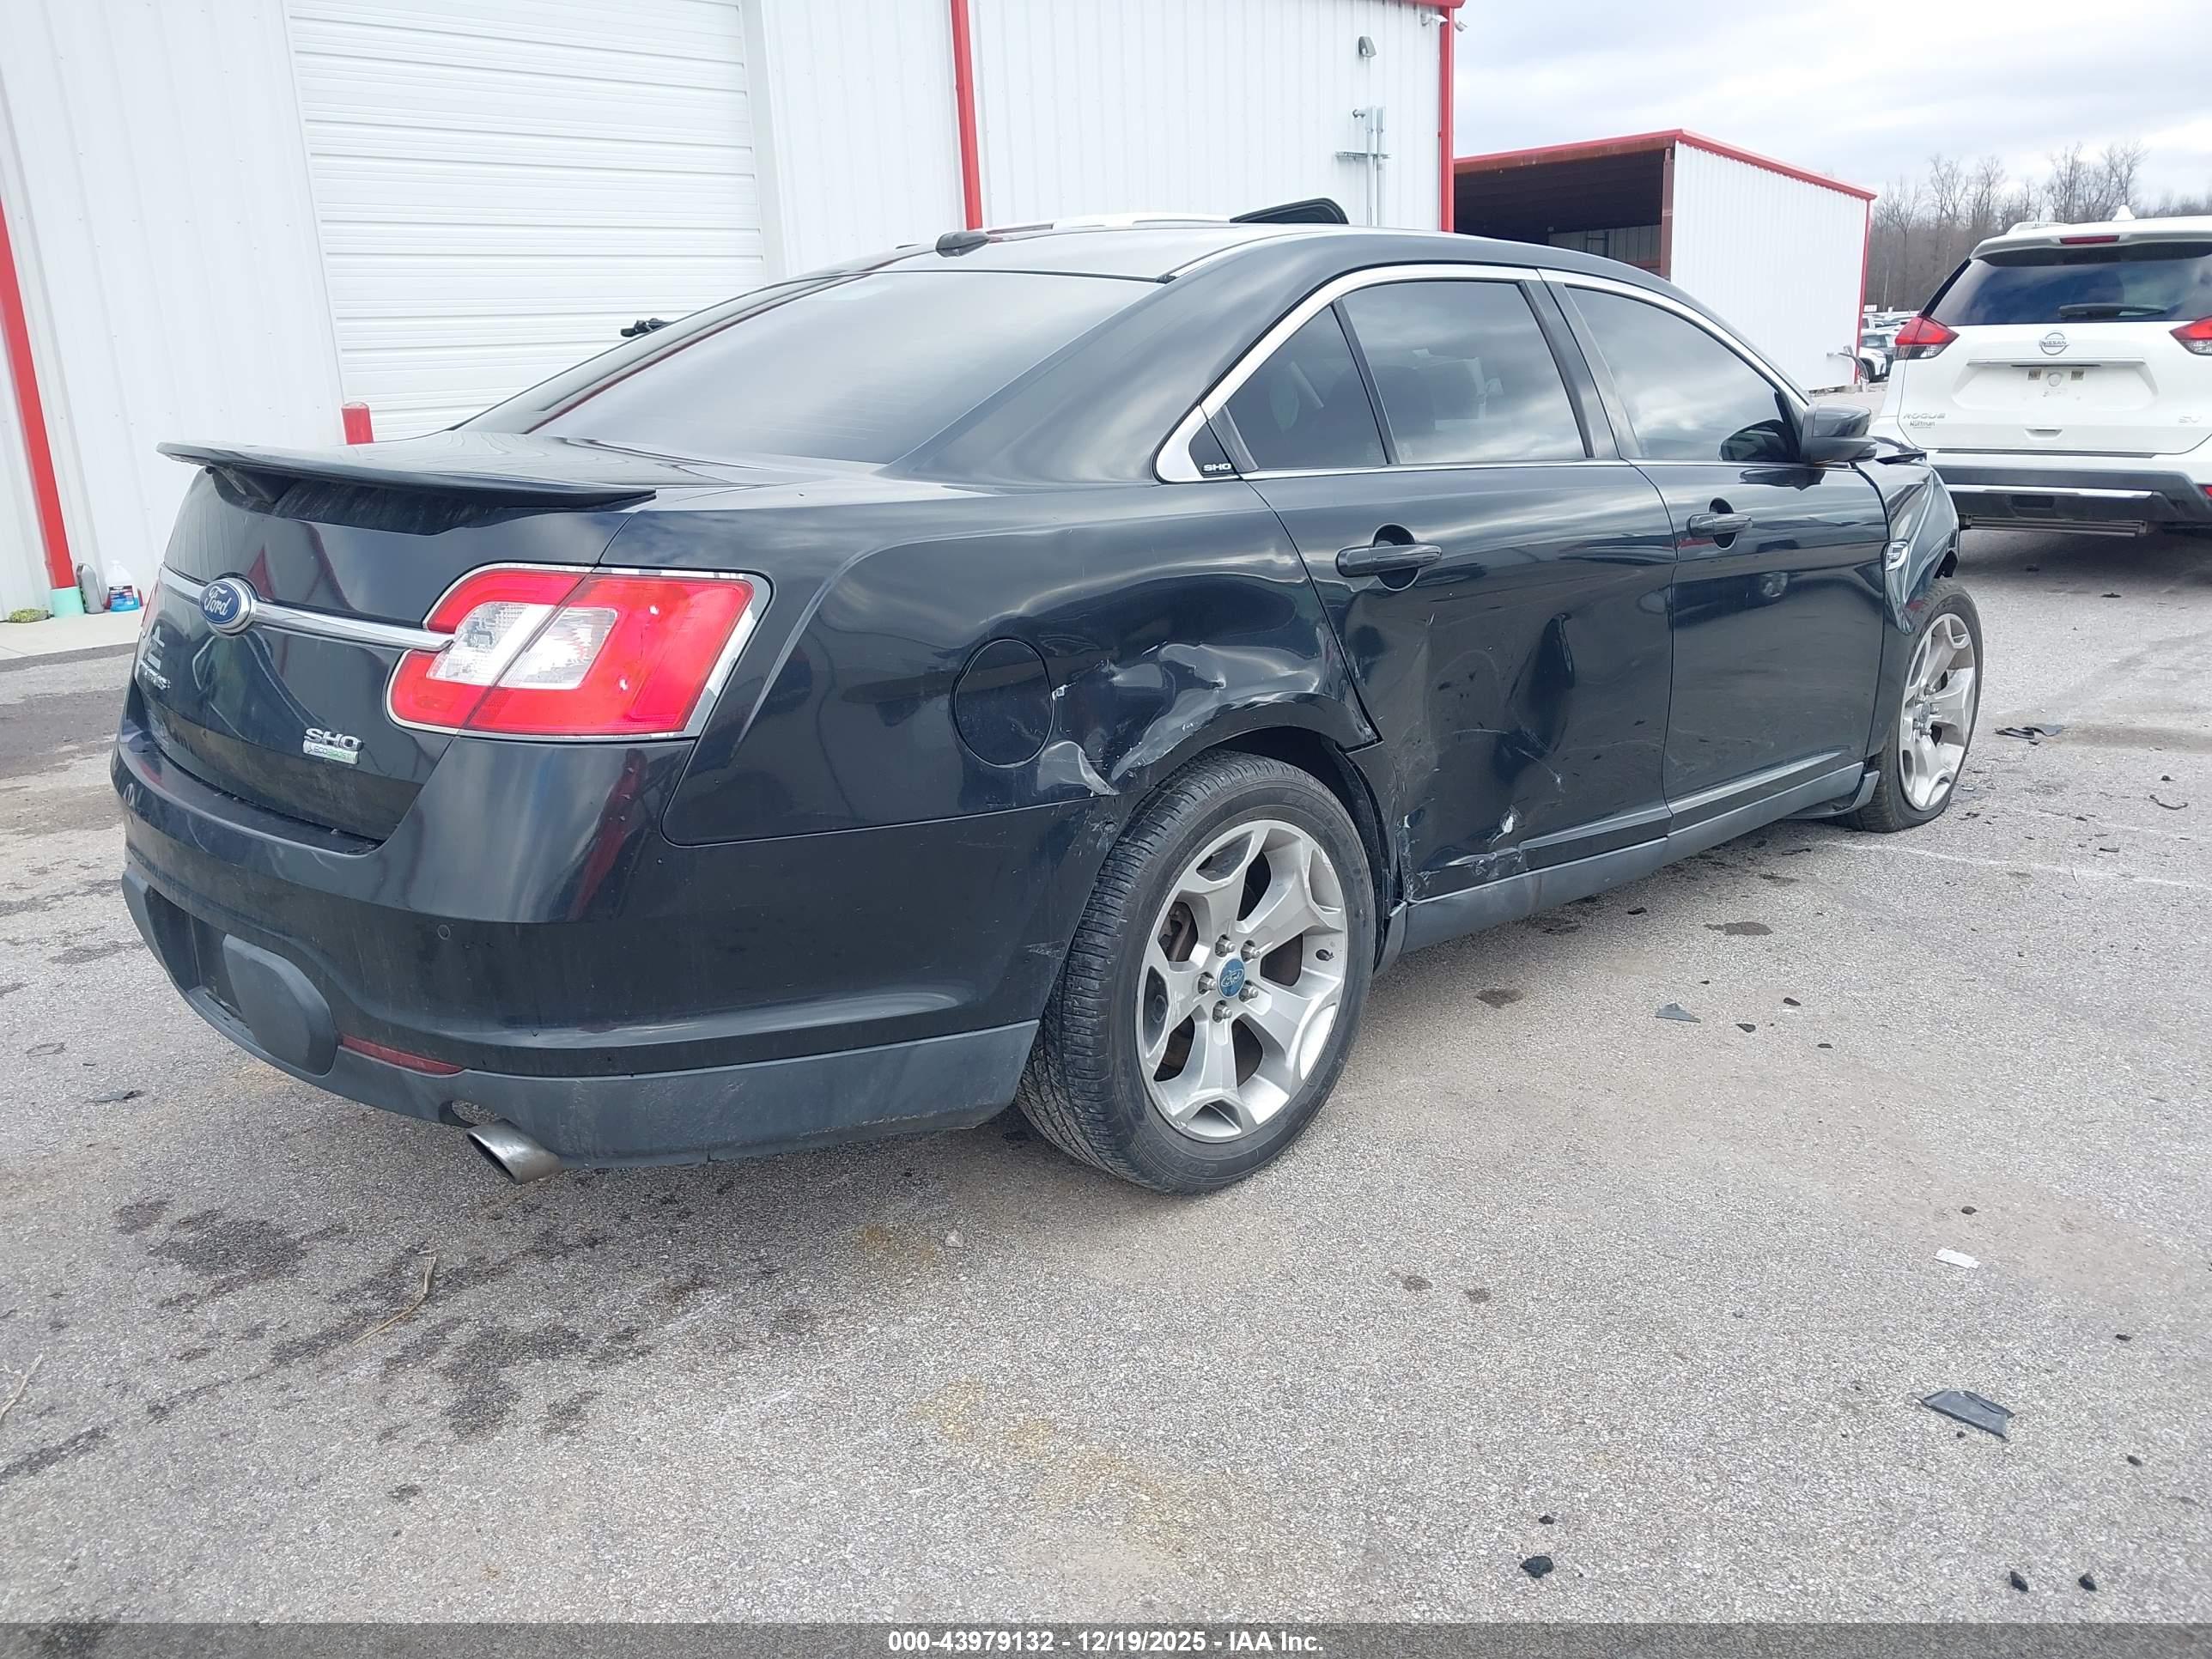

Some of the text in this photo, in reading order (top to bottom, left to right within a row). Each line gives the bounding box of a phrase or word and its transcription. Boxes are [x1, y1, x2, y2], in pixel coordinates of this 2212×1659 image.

[1203, 463, 1231, 471] SHO
[204, 586, 232, 616] Ford
[304, 728, 361, 751] SHO
